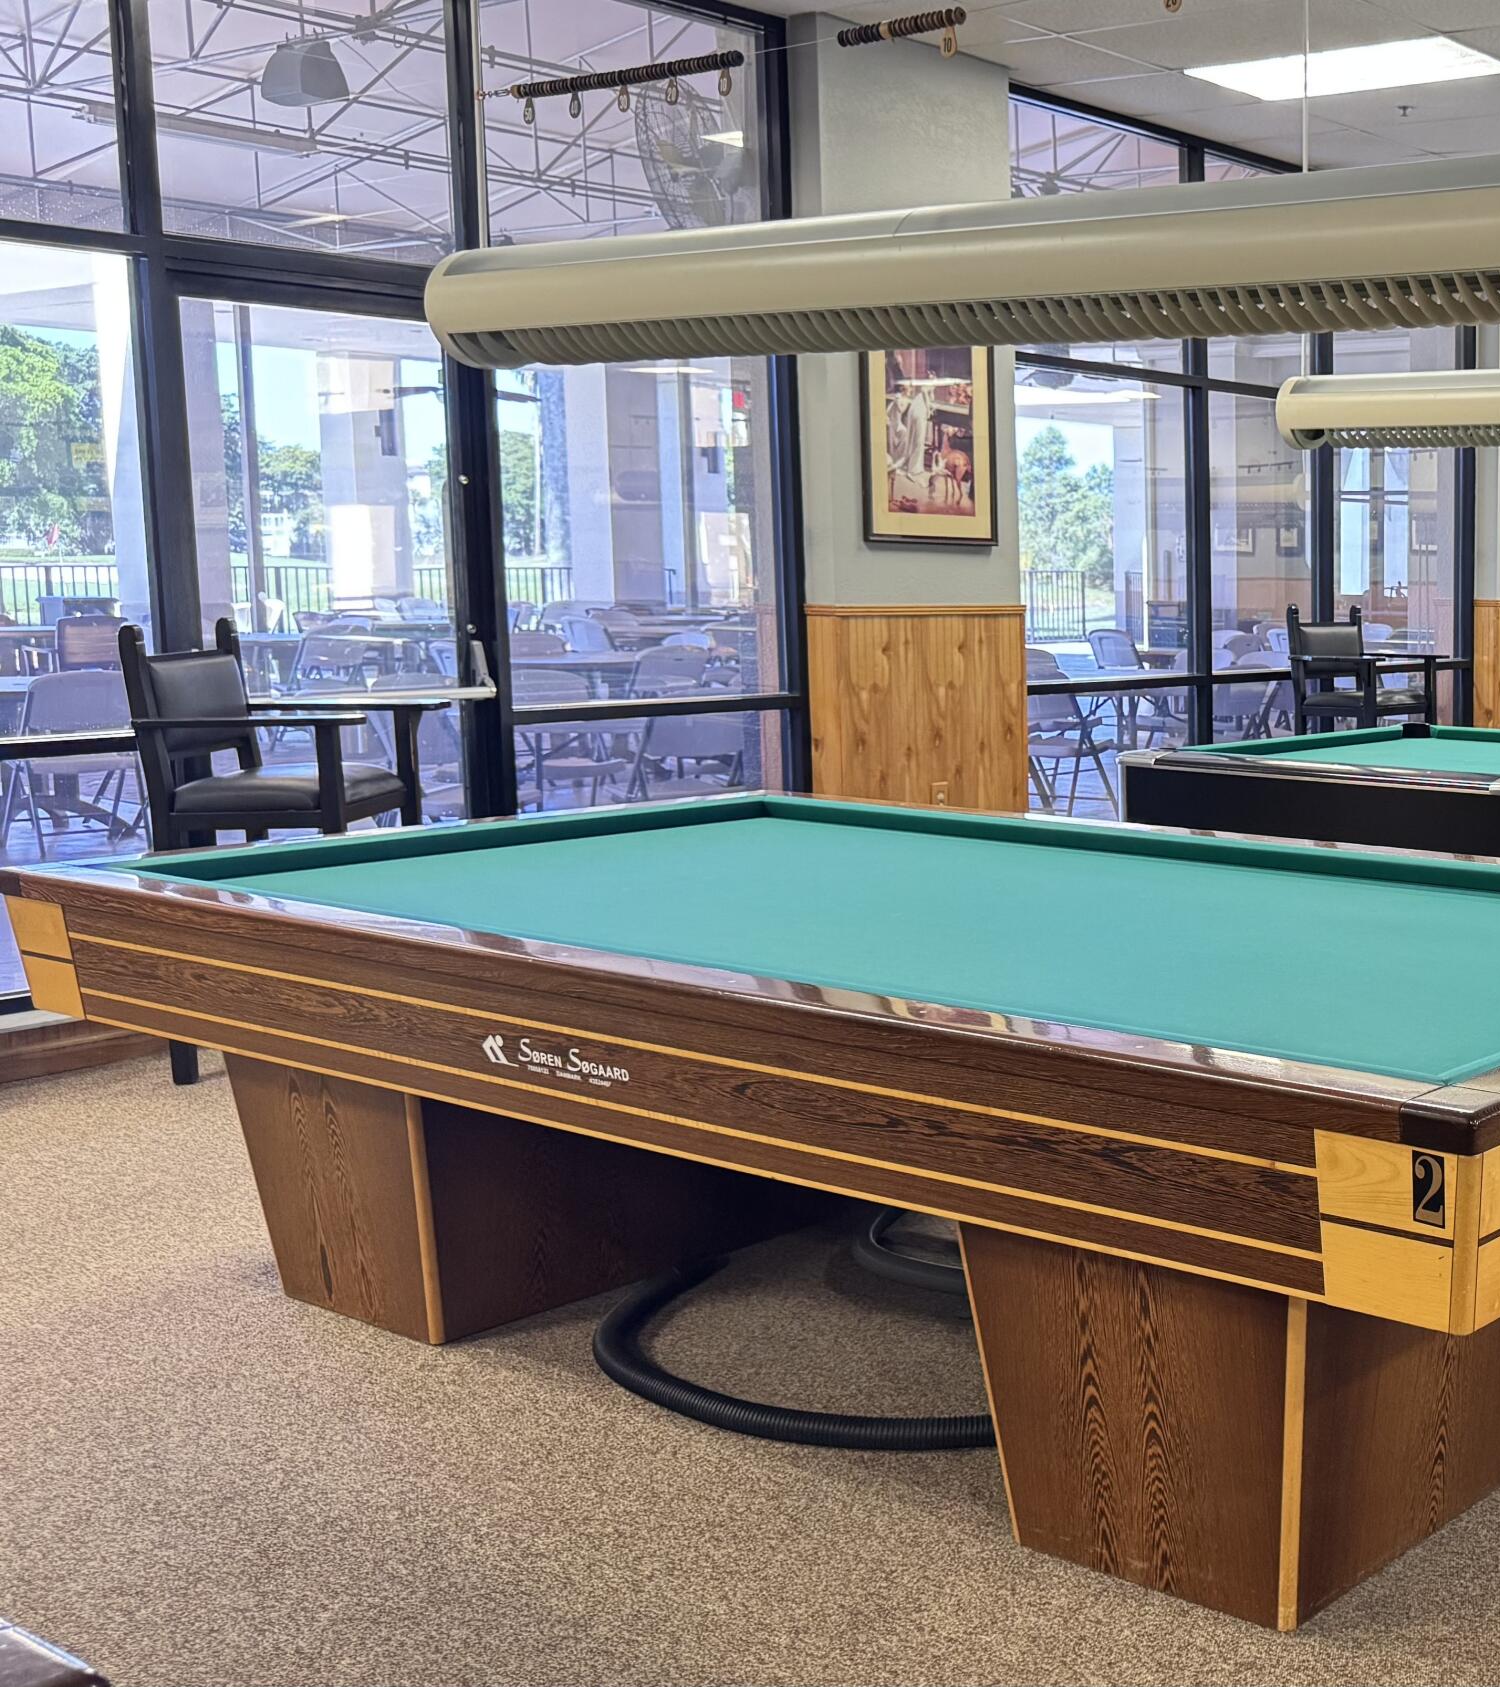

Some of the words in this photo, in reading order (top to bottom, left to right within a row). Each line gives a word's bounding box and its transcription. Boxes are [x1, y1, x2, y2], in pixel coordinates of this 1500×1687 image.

[943, 37, 951, 51] 10
[719, 77, 727, 93] 10
[666, 87, 676, 102] 20
[1414, 1155, 1443, 1226] 2
